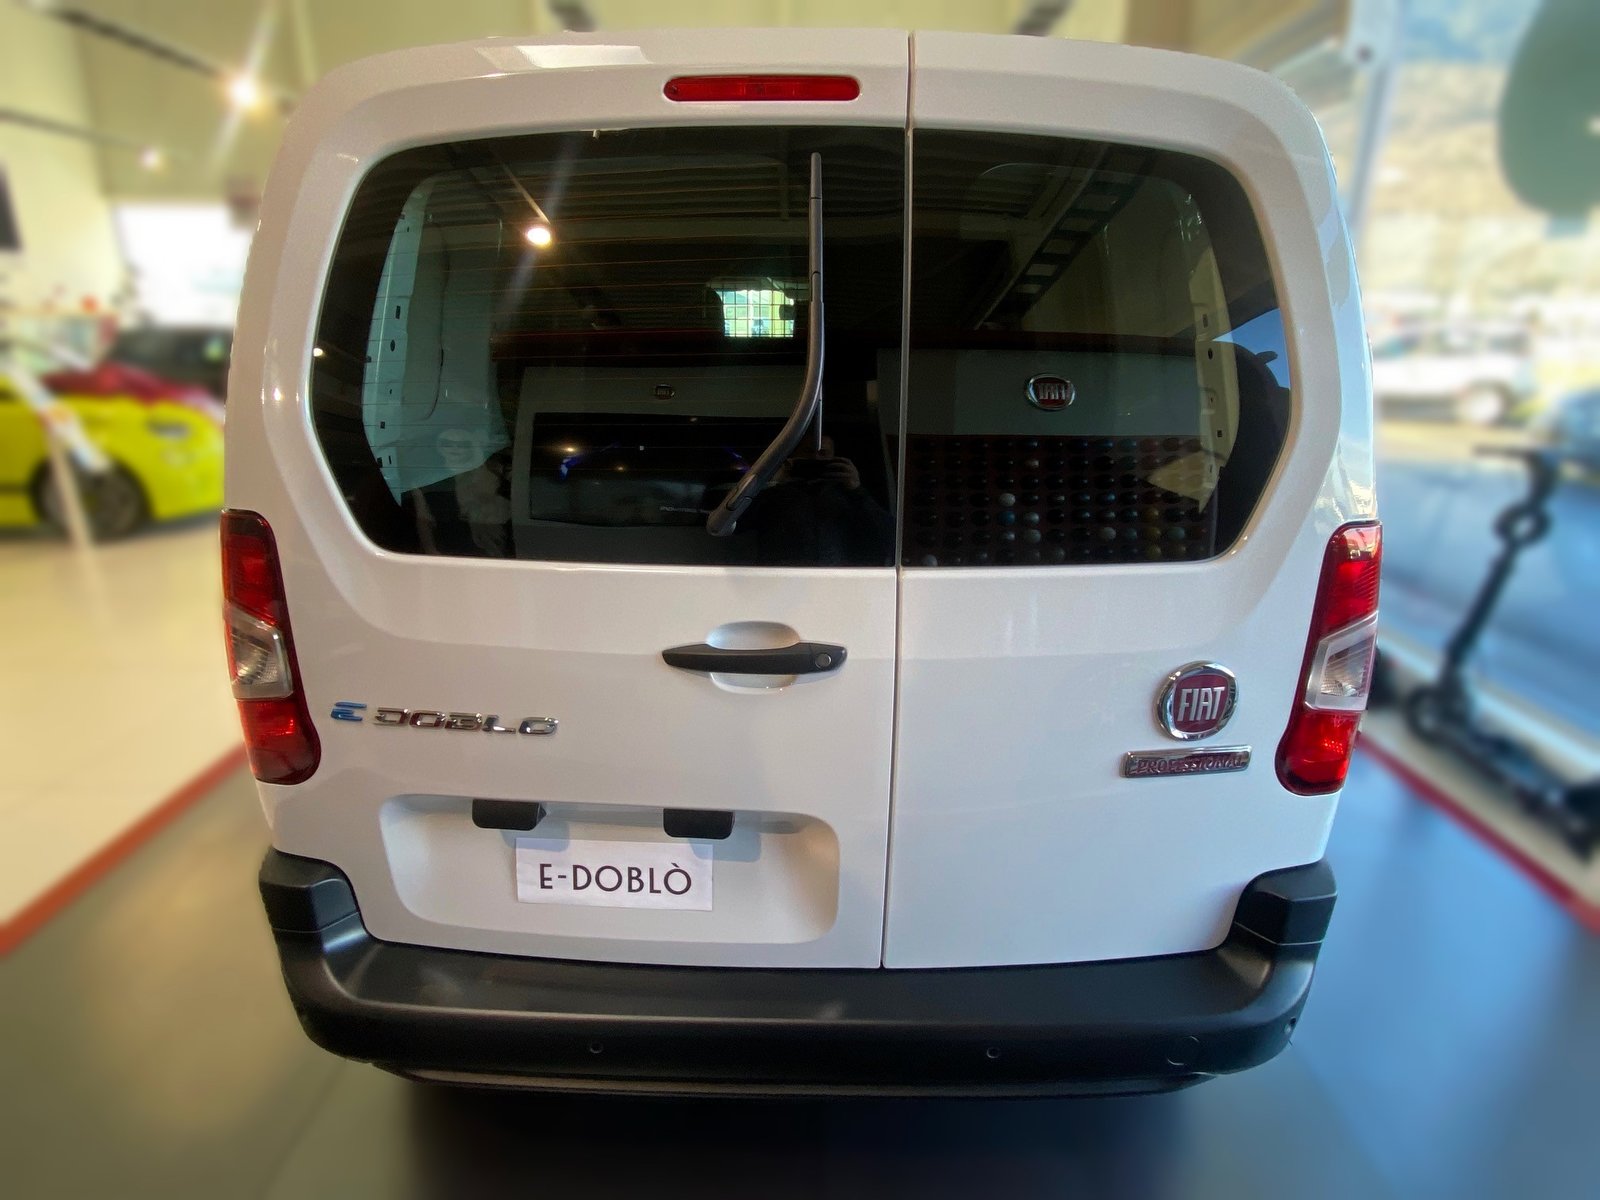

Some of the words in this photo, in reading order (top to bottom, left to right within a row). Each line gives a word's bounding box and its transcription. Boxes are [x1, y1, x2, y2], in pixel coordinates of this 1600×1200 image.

[1177, 686, 1226, 722] FIAT
[1132, 754, 1244, 775] PROFESSIONAL
[539, 862, 692, 895] E-DOBLÒ
